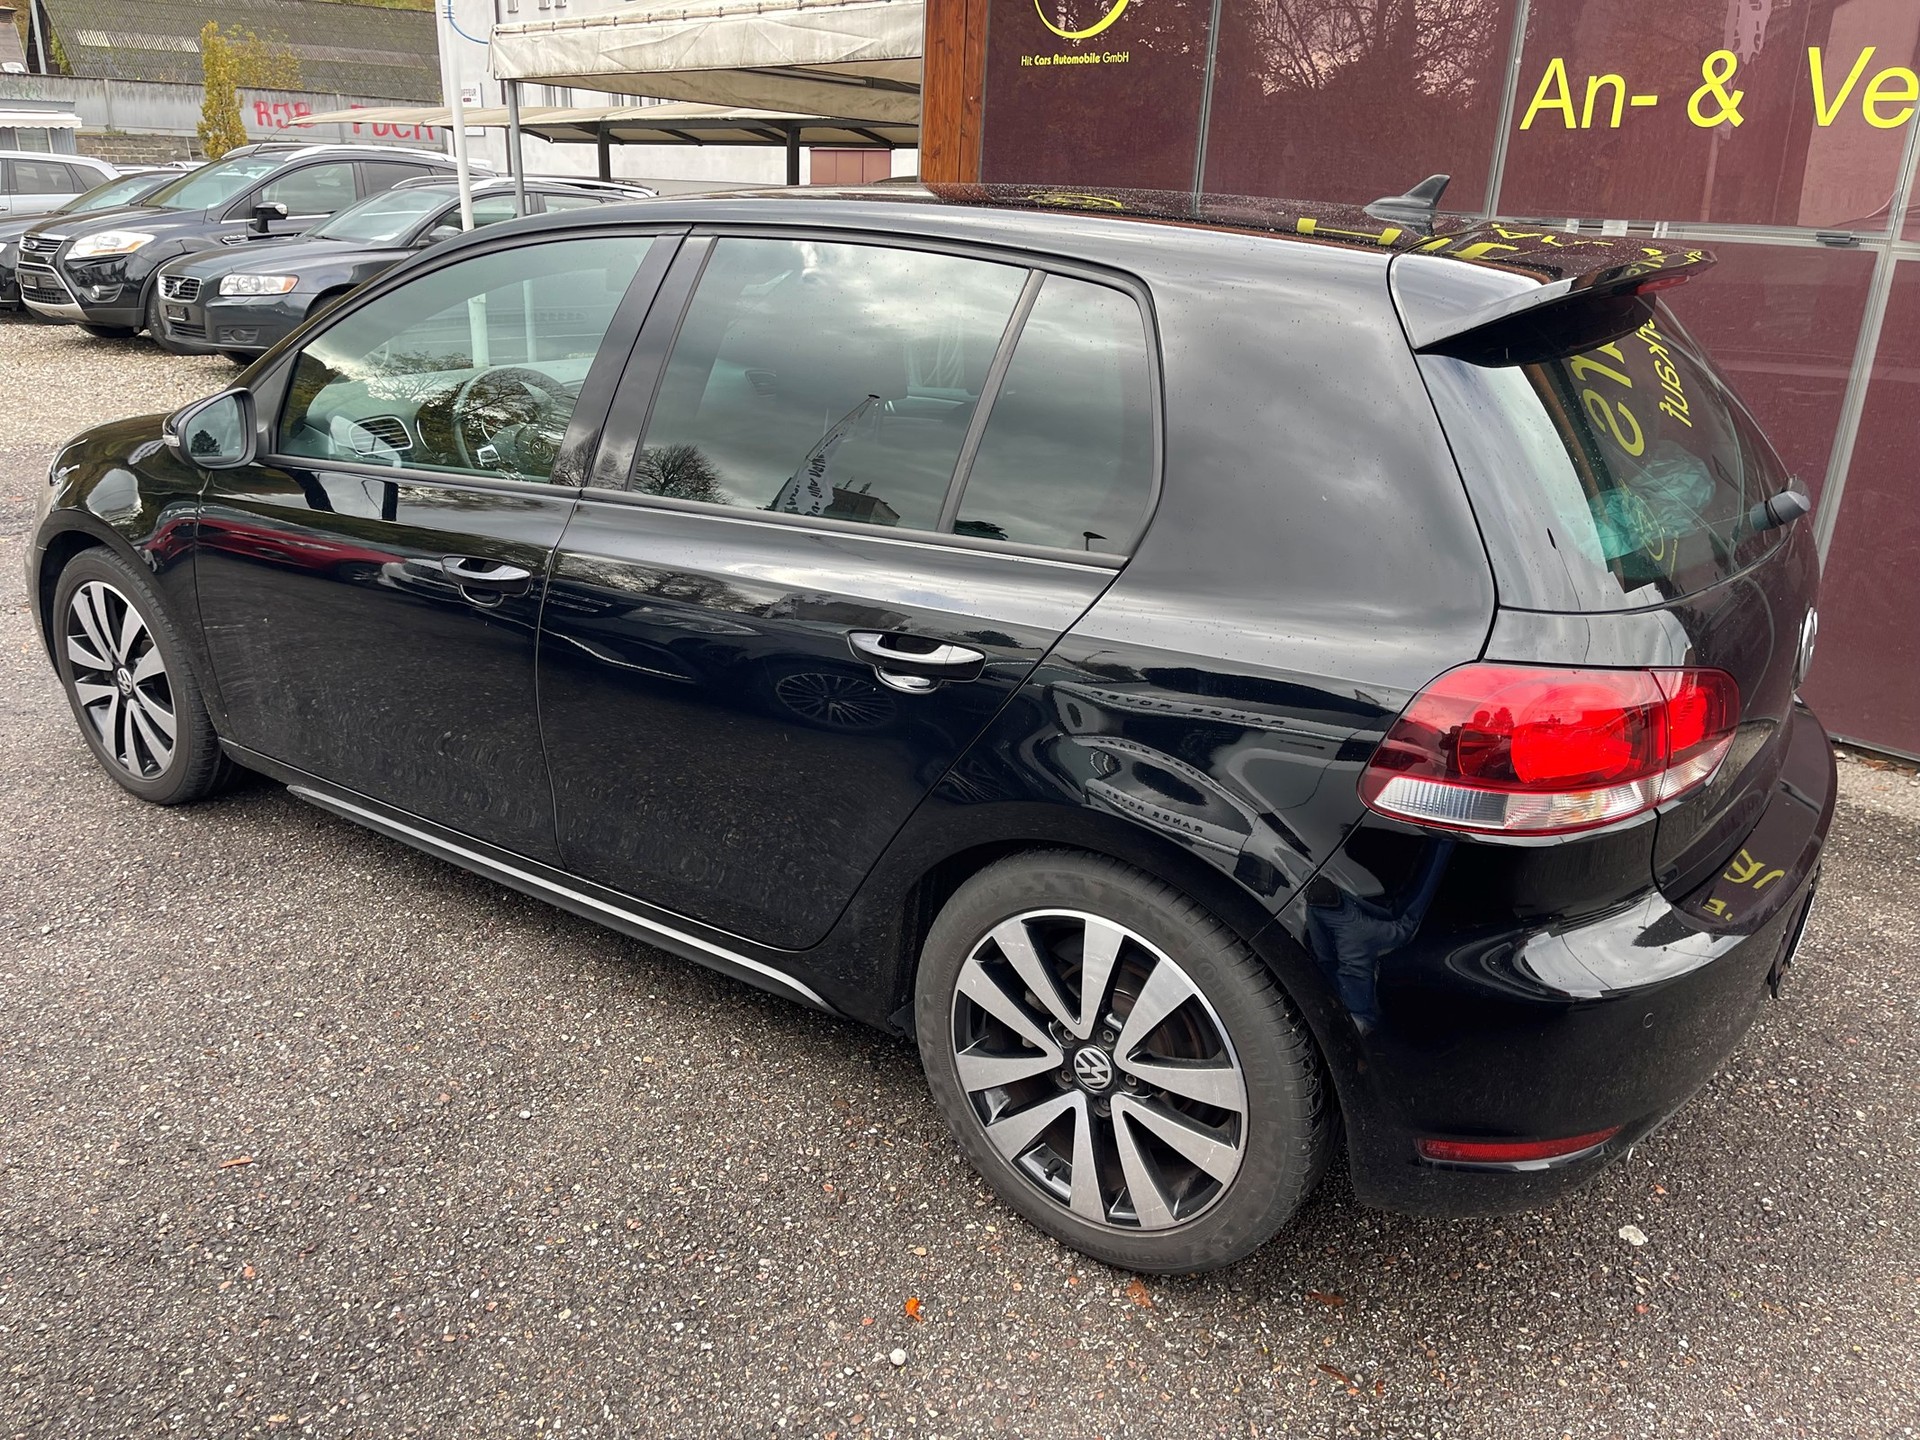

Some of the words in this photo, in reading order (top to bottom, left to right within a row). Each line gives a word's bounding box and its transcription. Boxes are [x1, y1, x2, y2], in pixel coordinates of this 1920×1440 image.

[1020, 55, 1032, 66] Hit
[1033, 54, 1052, 66] Cars
[1052, 52, 1101, 65] Automobile
[1102, 51, 1130, 63] GmbH
[1519, 57, 1659, 130] An-
[1686, 47, 1744, 128] &
